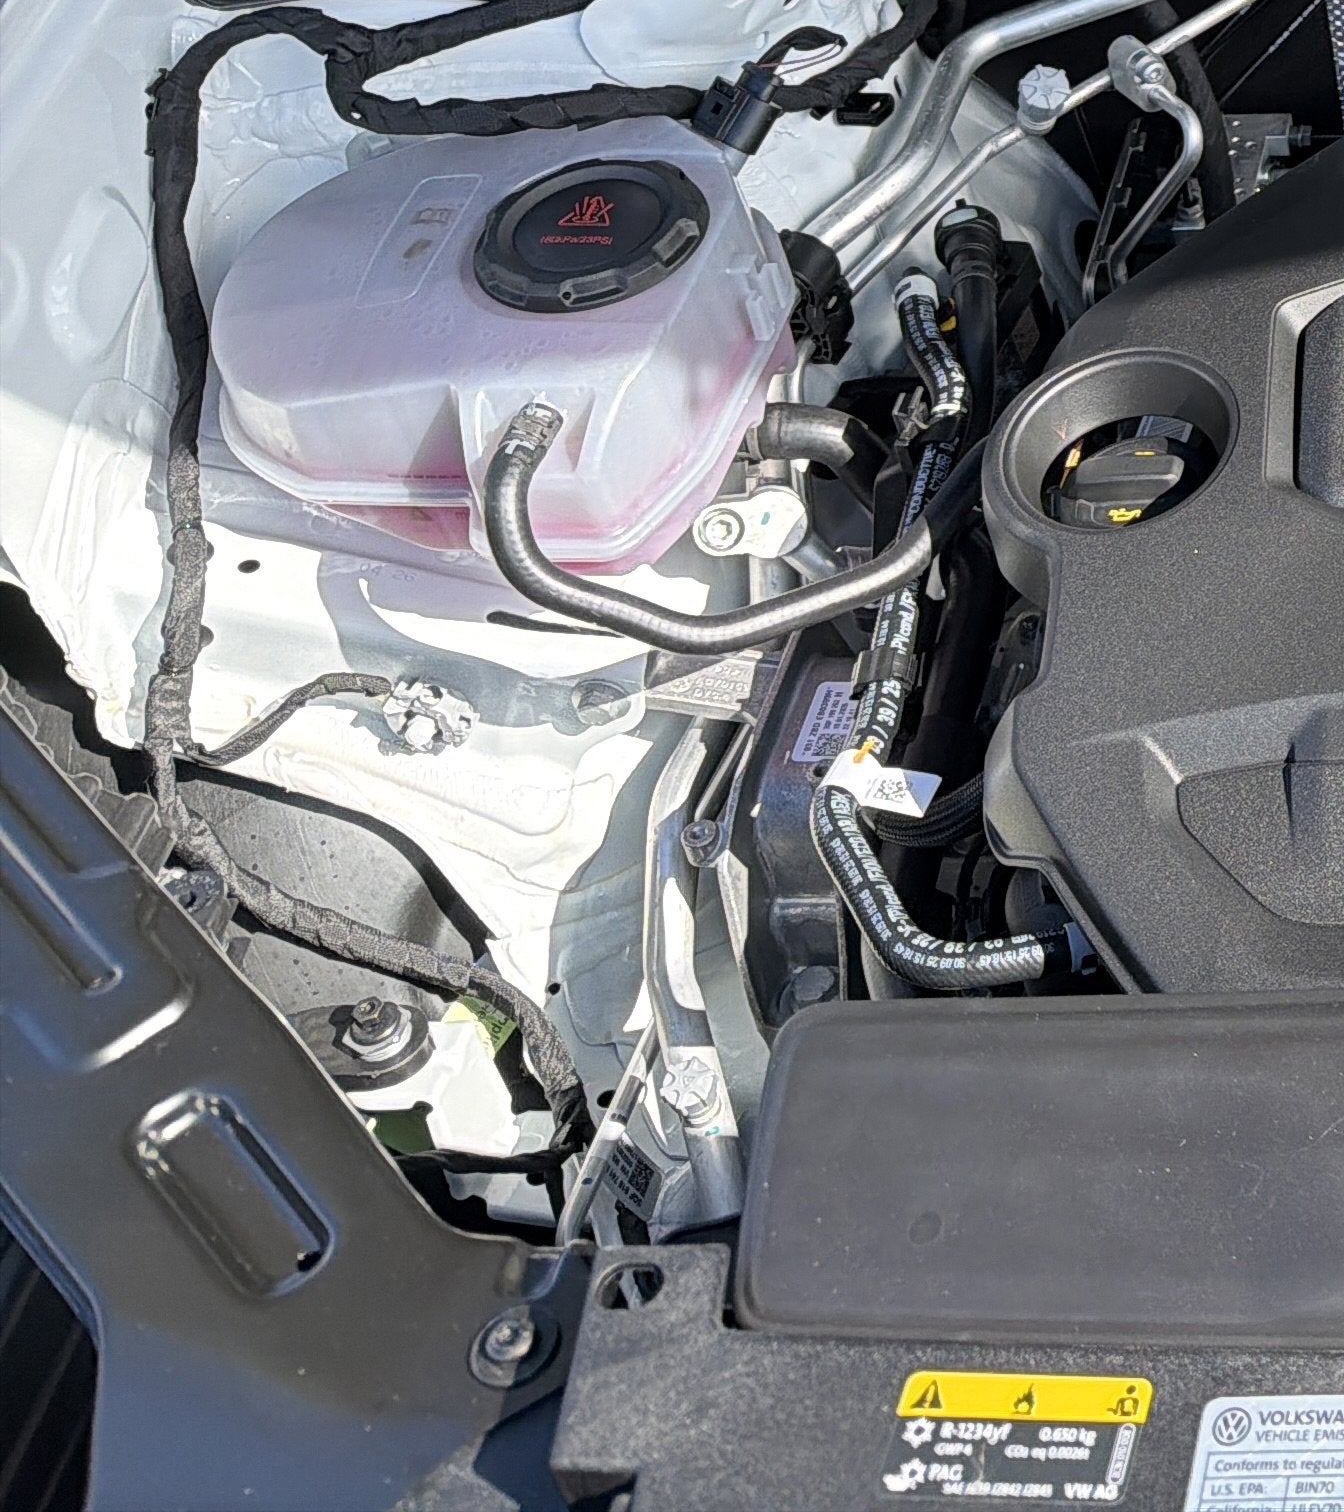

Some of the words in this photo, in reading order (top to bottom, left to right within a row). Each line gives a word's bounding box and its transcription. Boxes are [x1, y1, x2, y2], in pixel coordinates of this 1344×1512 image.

[939, 1421, 1013, 1446] R-1234yf
[1039, 1426, 1077, 1443] 0.650
[1078, 1427, 1098, 1447] kg
[1255, 1429, 1309, 1445] VEHICLE
[926, 1463, 964, 1481] PAG
[1214, 1458, 1279, 1473] Conforms
[1283, 1458, 1297, 1470] to
[1064, 1482, 1091, 1499] VW
[1091, 1482, 1119, 1500] AG
[1295, 1481, 1335, 1494] BIN70
